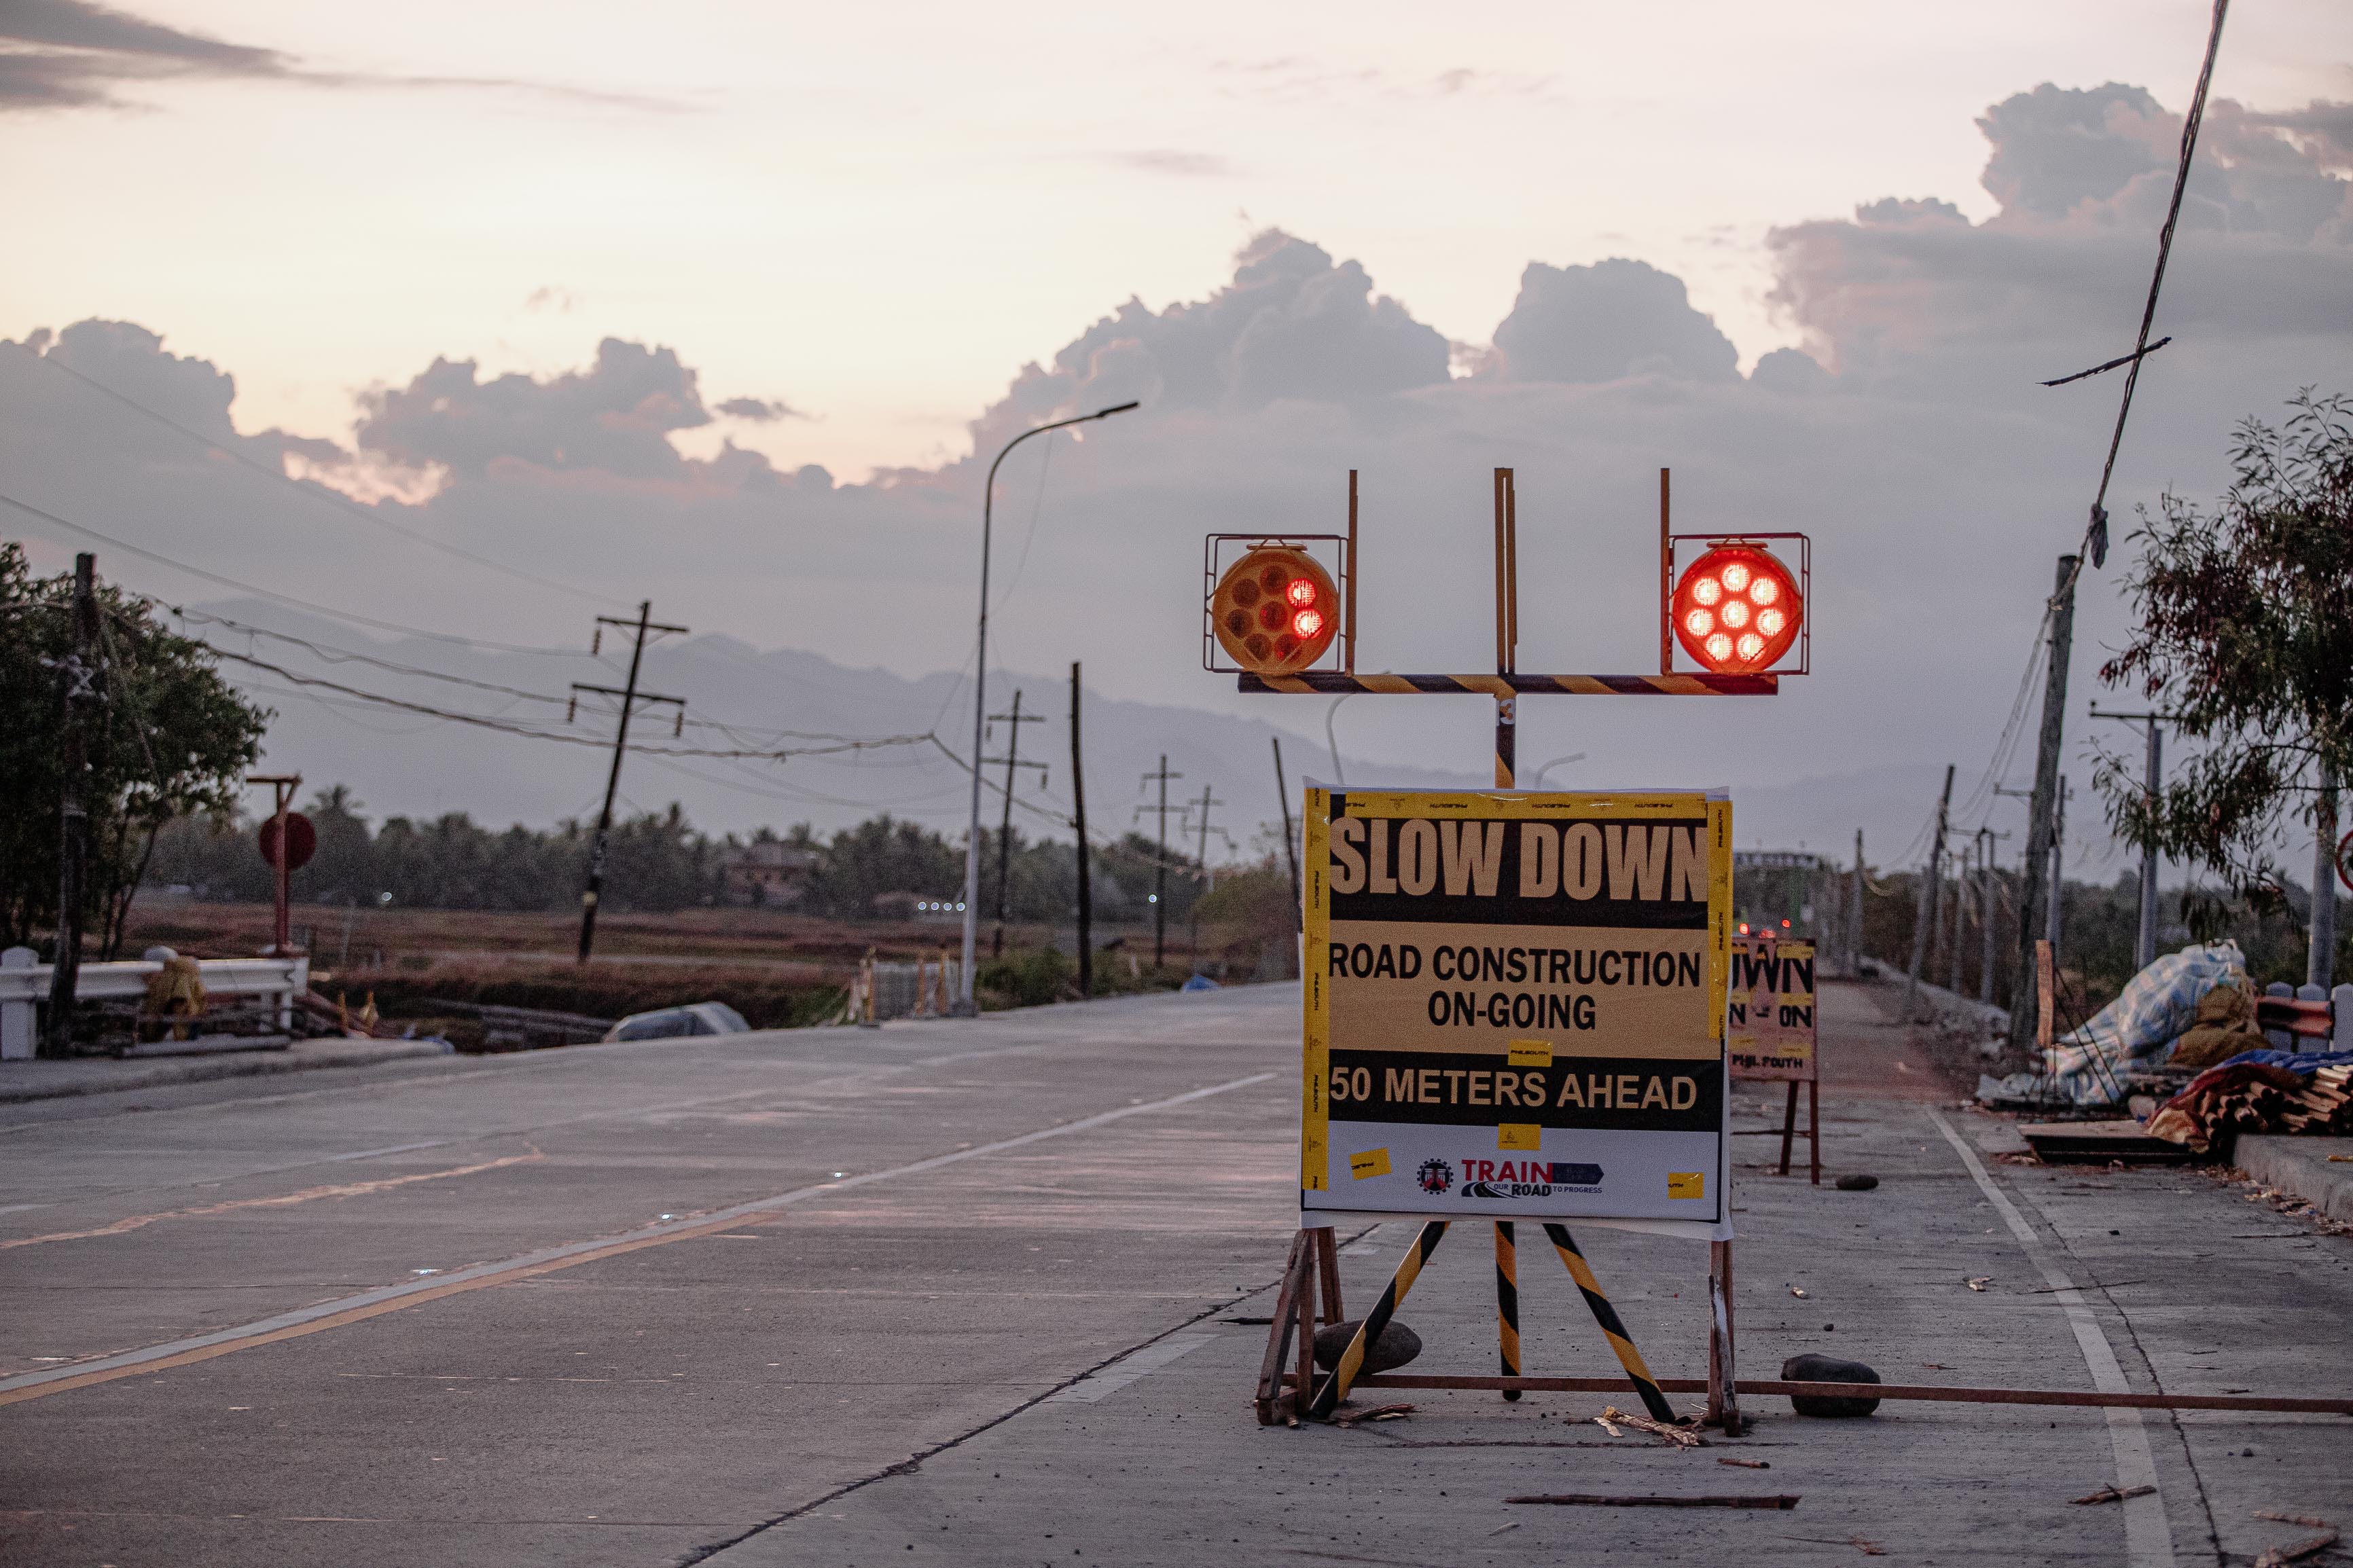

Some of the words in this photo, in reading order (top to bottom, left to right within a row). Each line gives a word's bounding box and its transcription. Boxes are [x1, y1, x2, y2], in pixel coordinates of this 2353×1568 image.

[1330, 816, 1505, 896] SLOW
[1519, 822, 1708, 902] DOWN
[1329, 943, 1422, 979] ROAD
[1433, 945, 1700, 987] CONSTRUCTION
[1428, 990, 1596, 1030] ON-GOING
[1329, 1066, 1371, 1101] 50
[1385, 1068, 1546, 1107] METERS
[1557, 1073, 1697, 1110] AHEAD
[1461, 1159, 1553, 1184] TRAIN
[1511, 1183, 1553, 1197] ROAD
